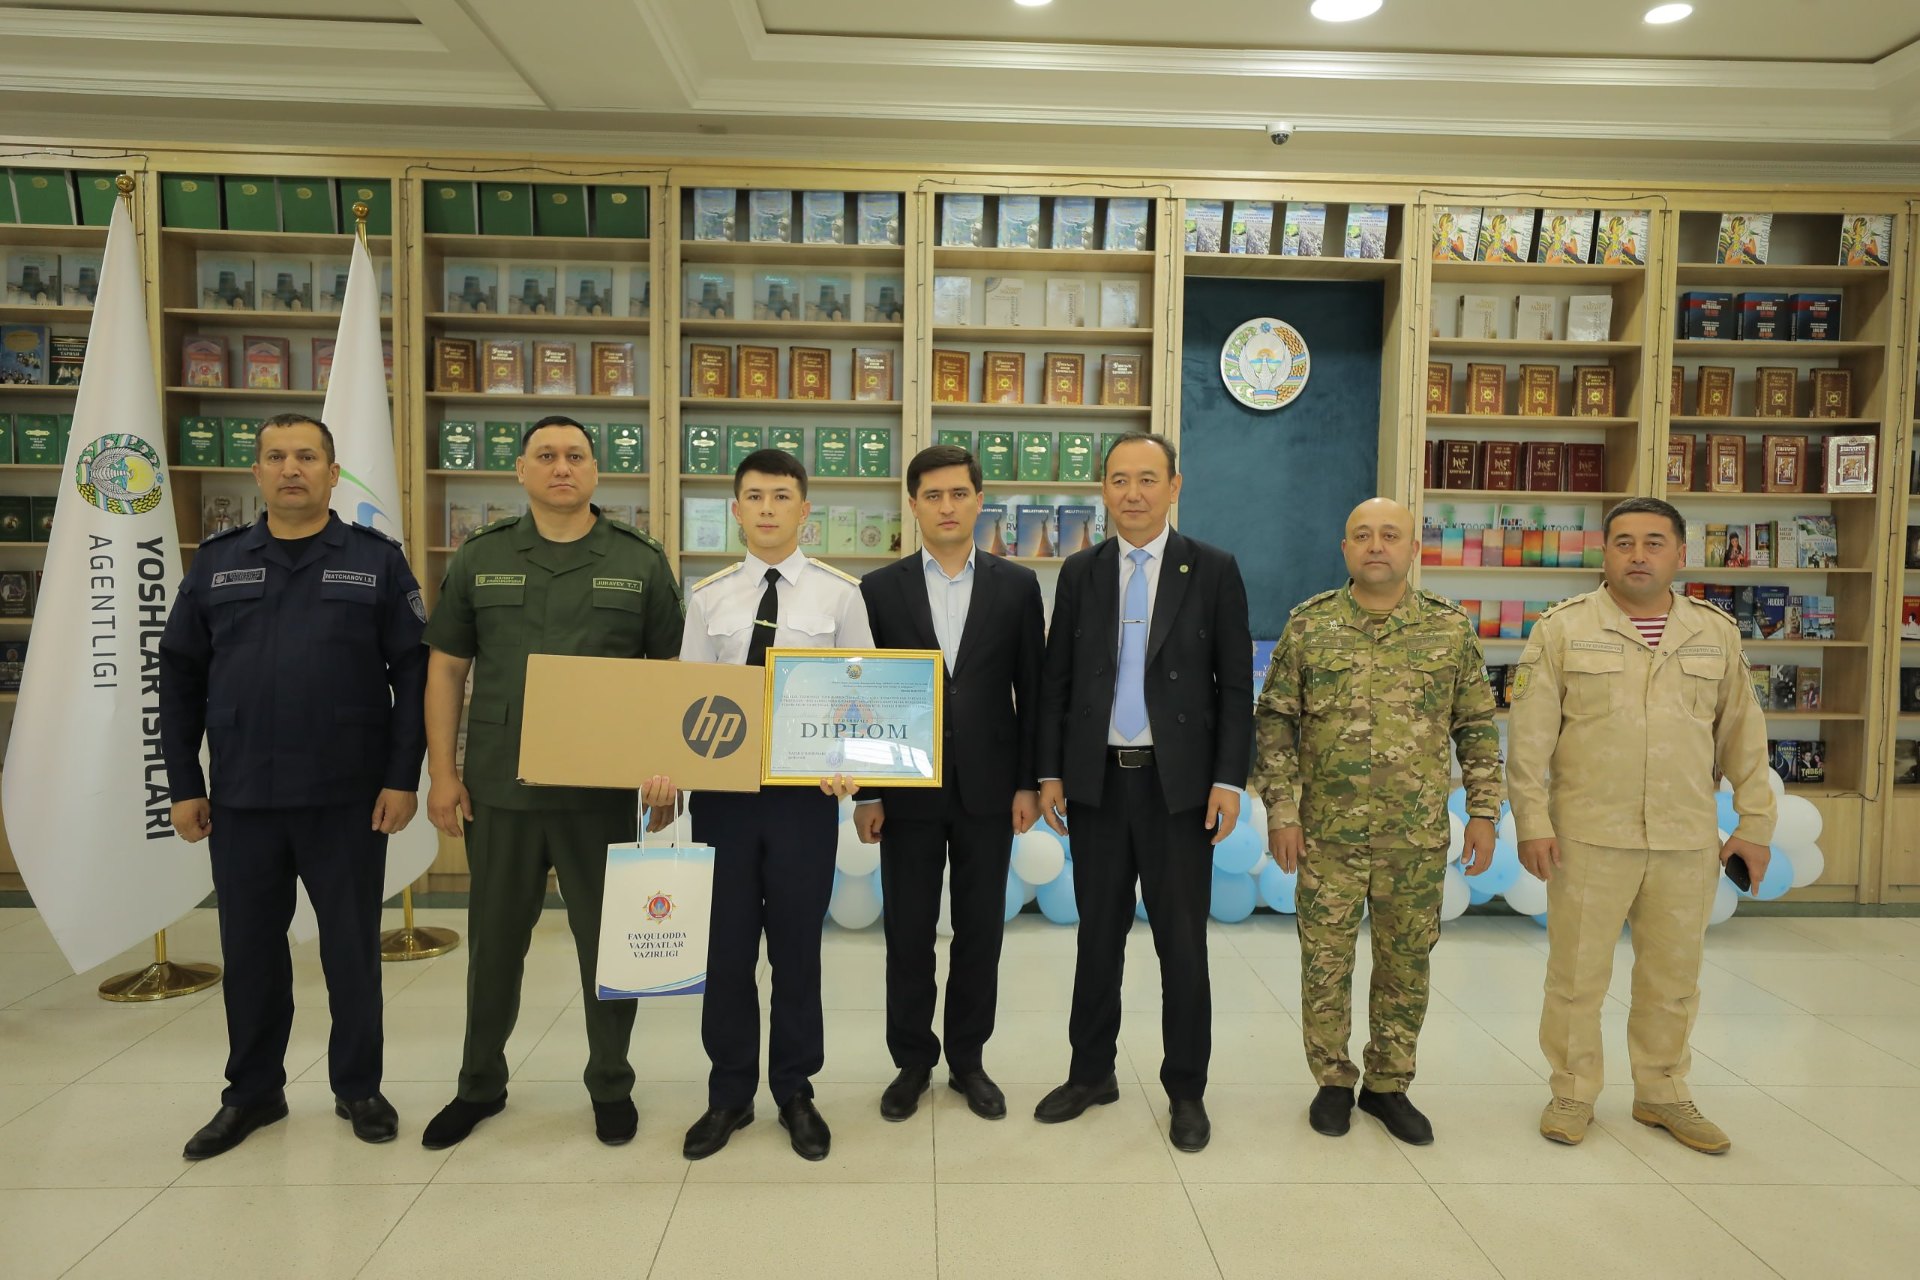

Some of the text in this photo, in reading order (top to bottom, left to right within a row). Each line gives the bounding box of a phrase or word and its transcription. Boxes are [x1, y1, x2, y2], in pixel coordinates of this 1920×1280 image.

[89, 534, 117, 688] AGENTLIGI
[137, 536, 175, 840] YOSHLAR ISHLARI
[683, 695, 747, 759] hp
[801, 722, 908, 739] DIPLOM
[628, 932, 687, 941] FAVQULODDA
[629, 941, 684, 949] VAZIYATLAR
[633, 950, 679, 958] VAZIRLIGI
